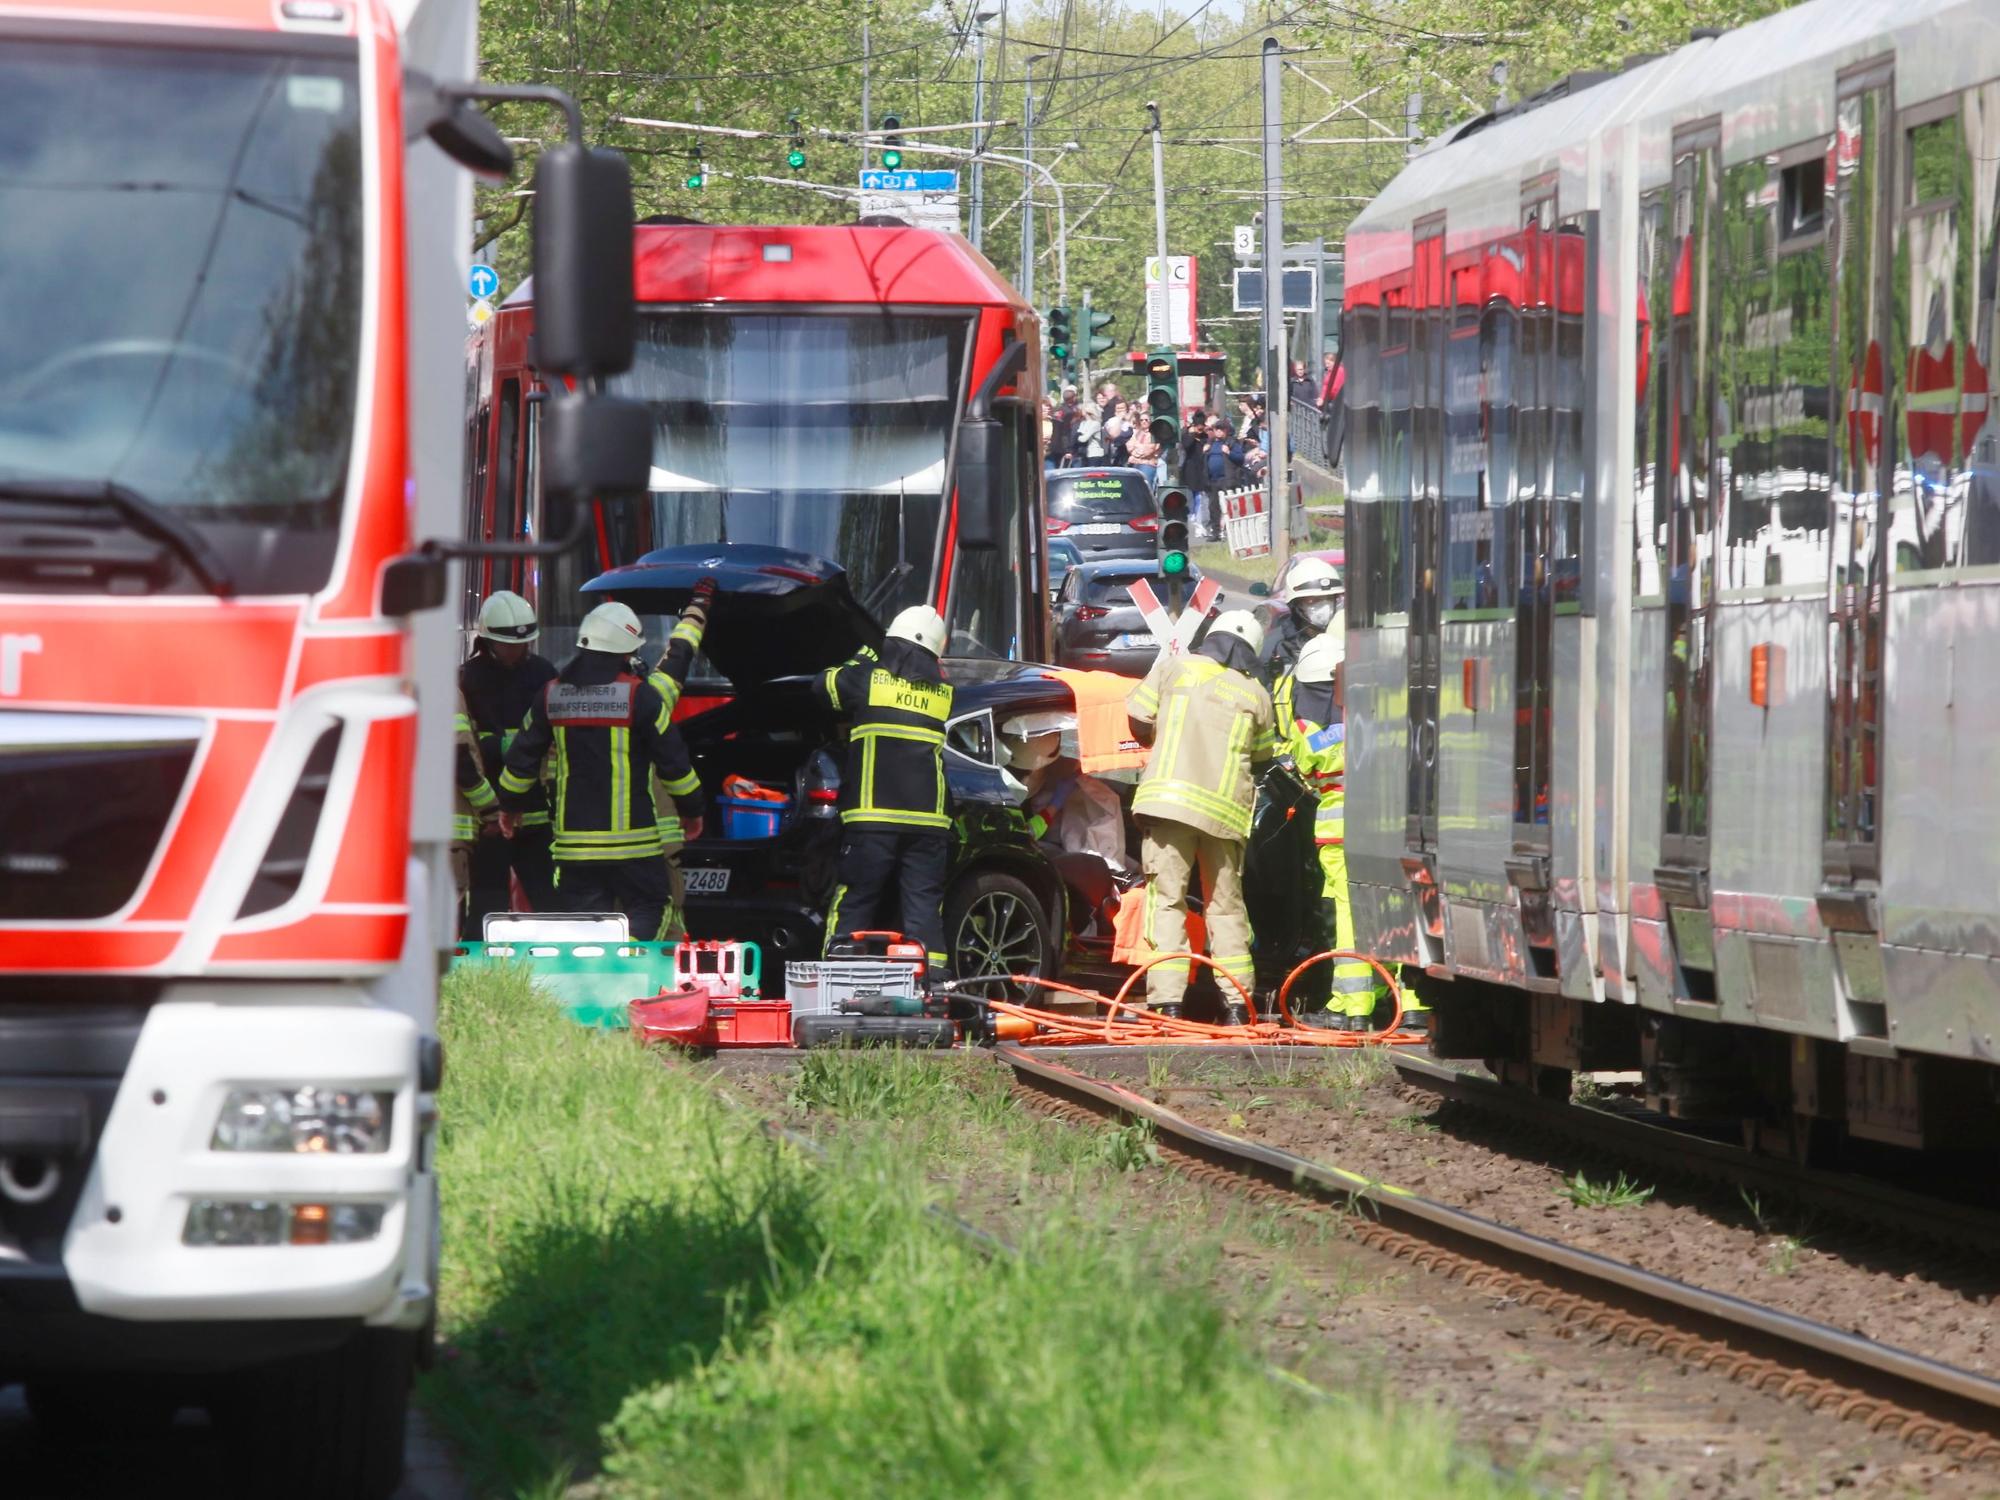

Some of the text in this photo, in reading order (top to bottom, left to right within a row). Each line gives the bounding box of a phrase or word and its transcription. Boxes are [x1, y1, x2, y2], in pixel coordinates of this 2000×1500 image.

[1239, 233, 1249, 249] 3
[1174, 265, 1186, 280] C
[896, 691, 929, 710] KÖLN
